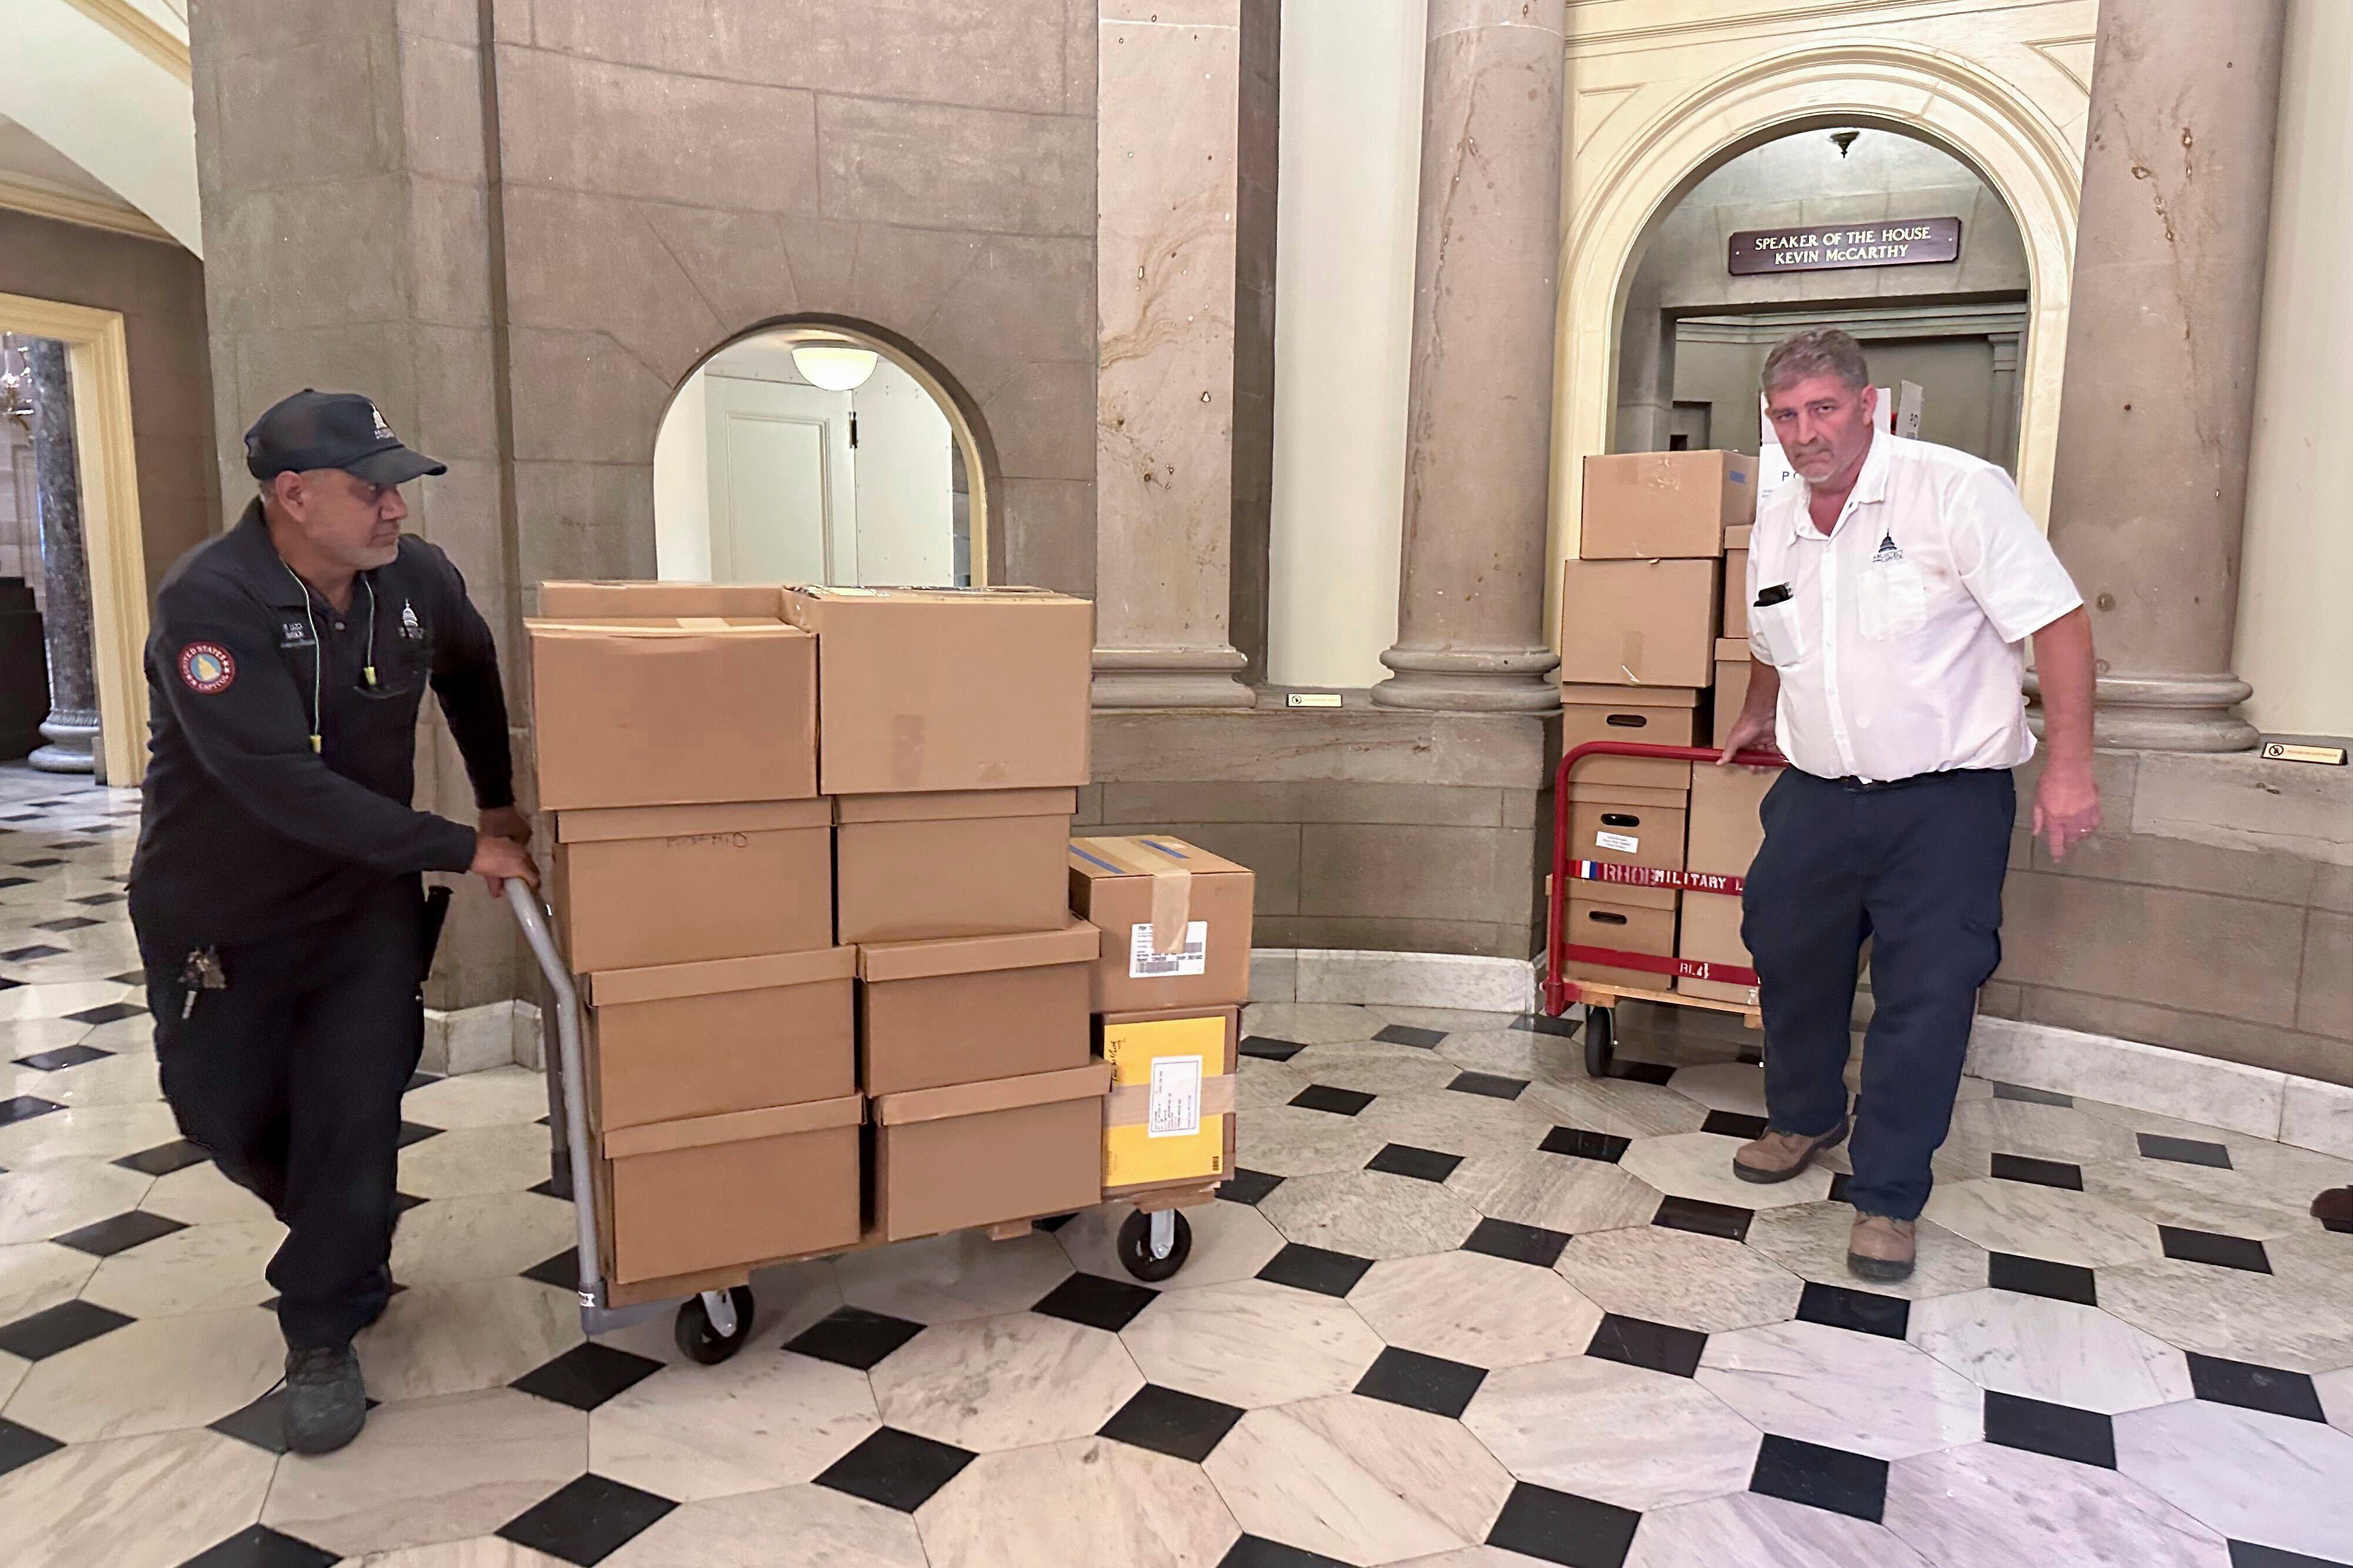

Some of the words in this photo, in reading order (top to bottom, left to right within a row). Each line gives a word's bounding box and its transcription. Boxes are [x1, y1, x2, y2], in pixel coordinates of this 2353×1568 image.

[1755, 235, 1818, 251] SPEAKER
[1823, 232, 1842, 247] OF
[1846, 231, 1876, 244] THE
[1882, 227, 1931, 242] HOUSE
[1774, 250, 1819, 265] KEVIN
[1825, 245, 1909, 262] McCARTHY
[1655, 869, 1726, 889] MILITARY
